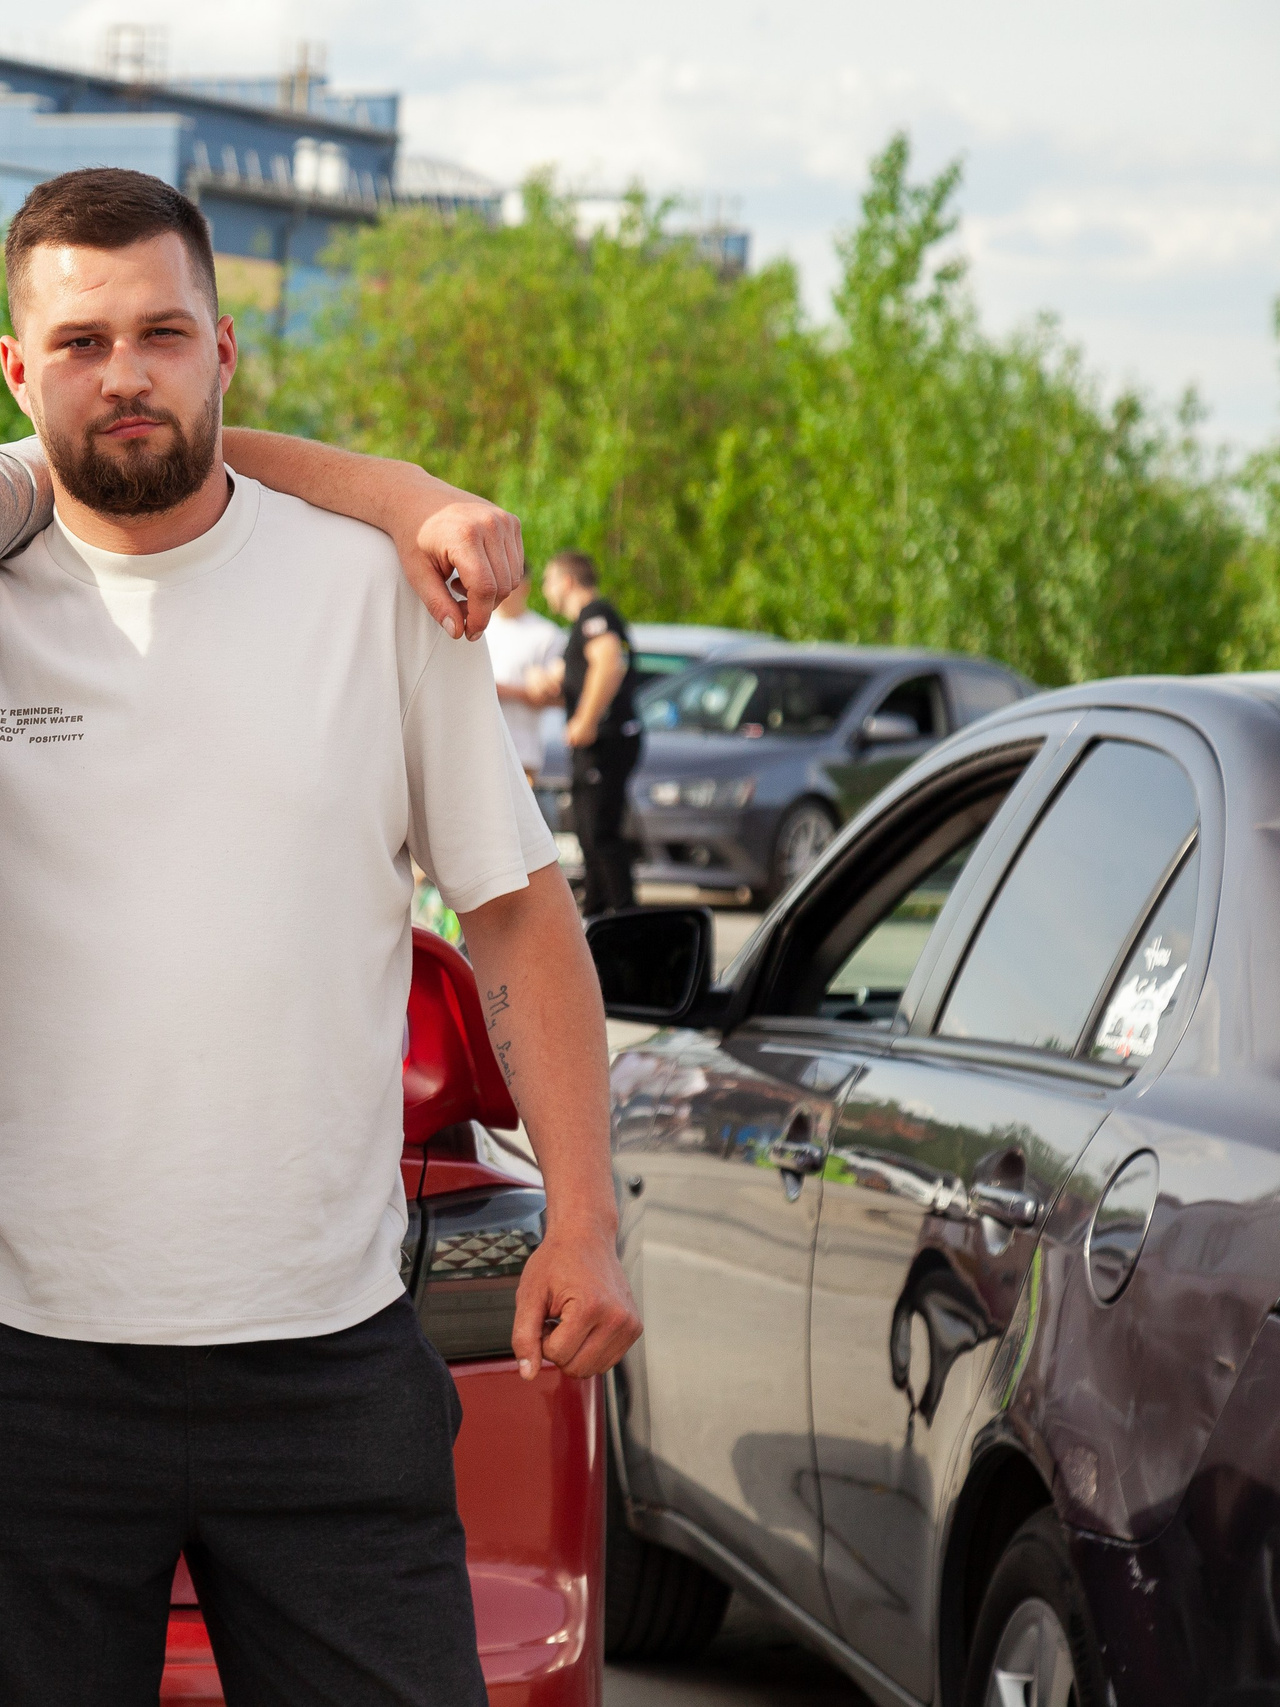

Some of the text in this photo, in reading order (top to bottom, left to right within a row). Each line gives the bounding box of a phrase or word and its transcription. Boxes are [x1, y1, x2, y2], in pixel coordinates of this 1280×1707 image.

[16, 717, 47, 725] DRINK
[50, 715, 84, 724] WATER
[29, 733, 84, 743] POSITIVITY
